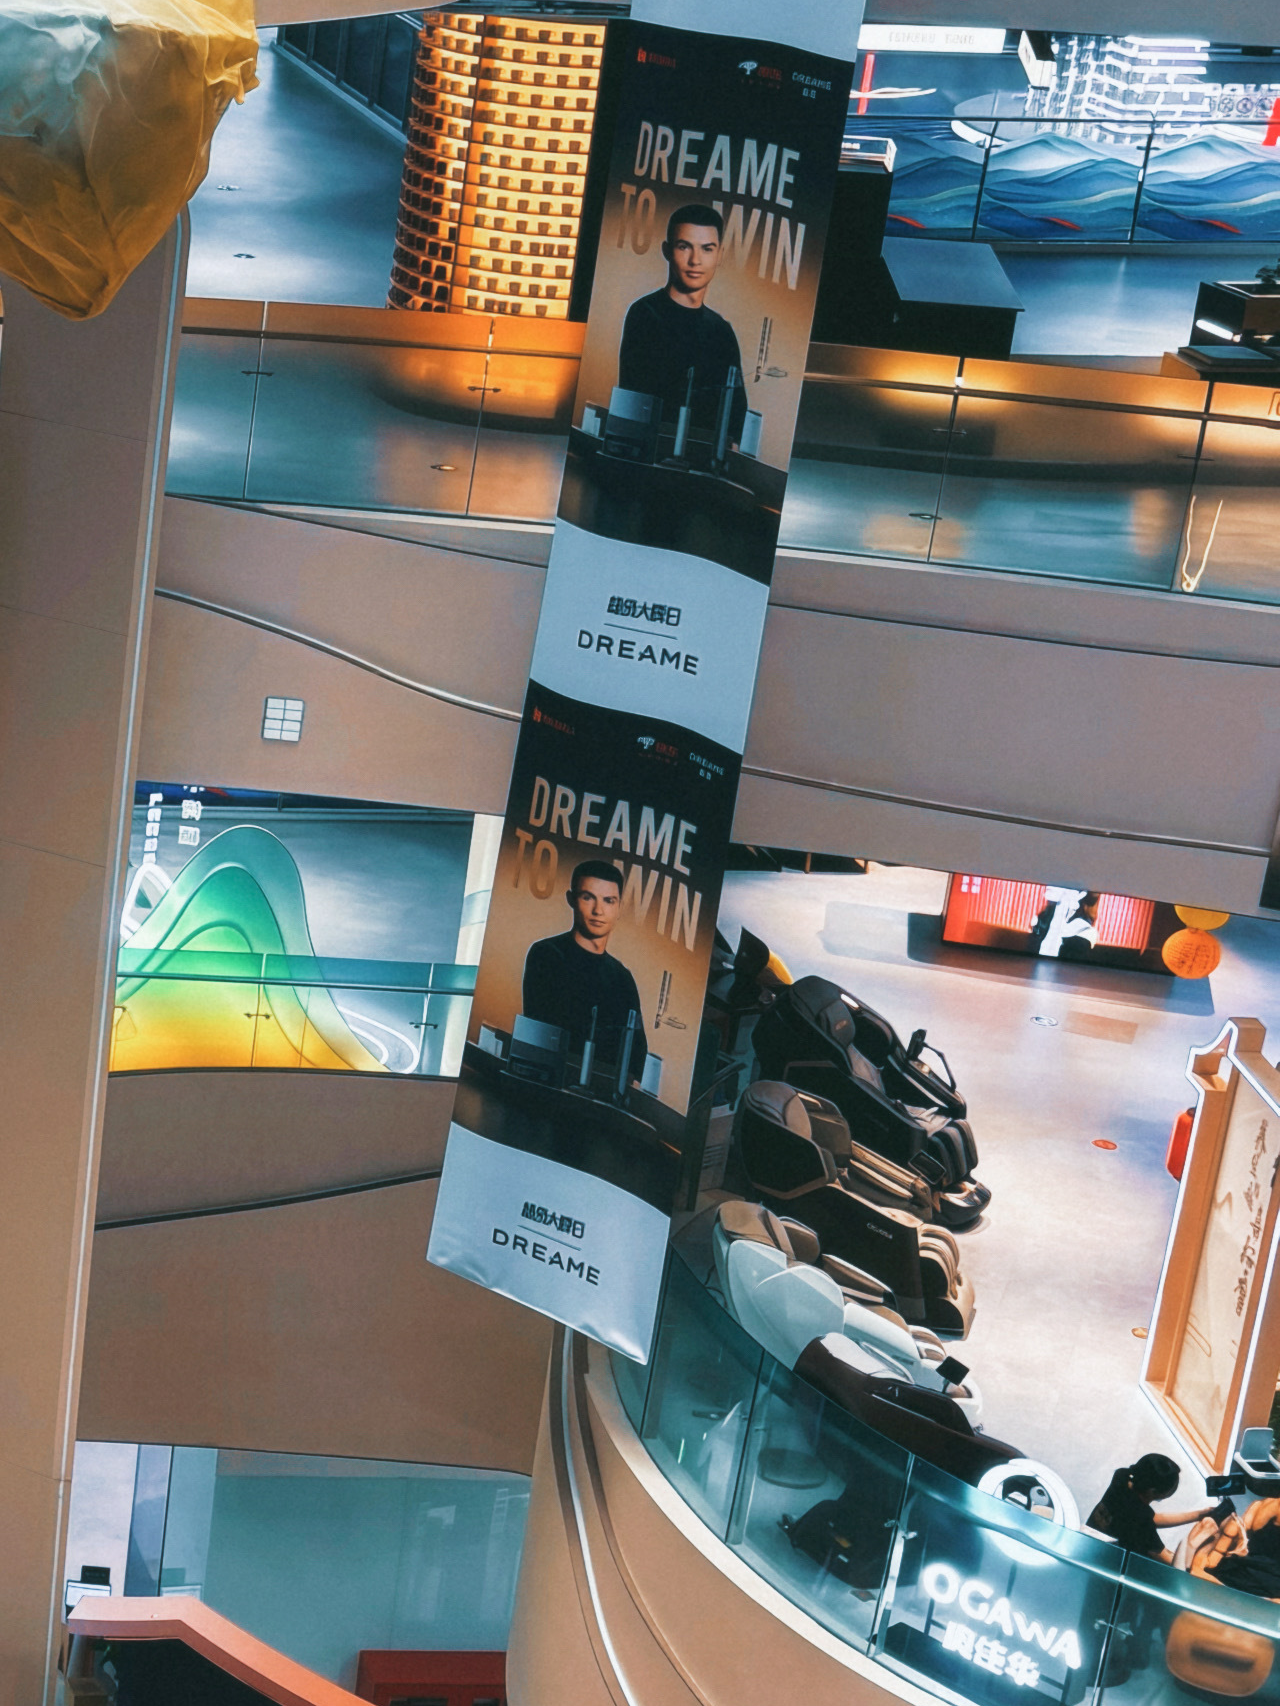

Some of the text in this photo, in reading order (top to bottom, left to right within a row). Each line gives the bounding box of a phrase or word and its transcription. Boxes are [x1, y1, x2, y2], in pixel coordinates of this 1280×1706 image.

[633, 120, 802, 209] DREAME
[617, 184, 807, 292] TO WIN
[576, 629, 700, 676] DREAME
[528, 776, 698, 874] DREAME
[511, 829, 703, 953] TO WIN
[492, 1227, 601, 1286] DREAME
[922, 1562, 1083, 1670] OGAWA
